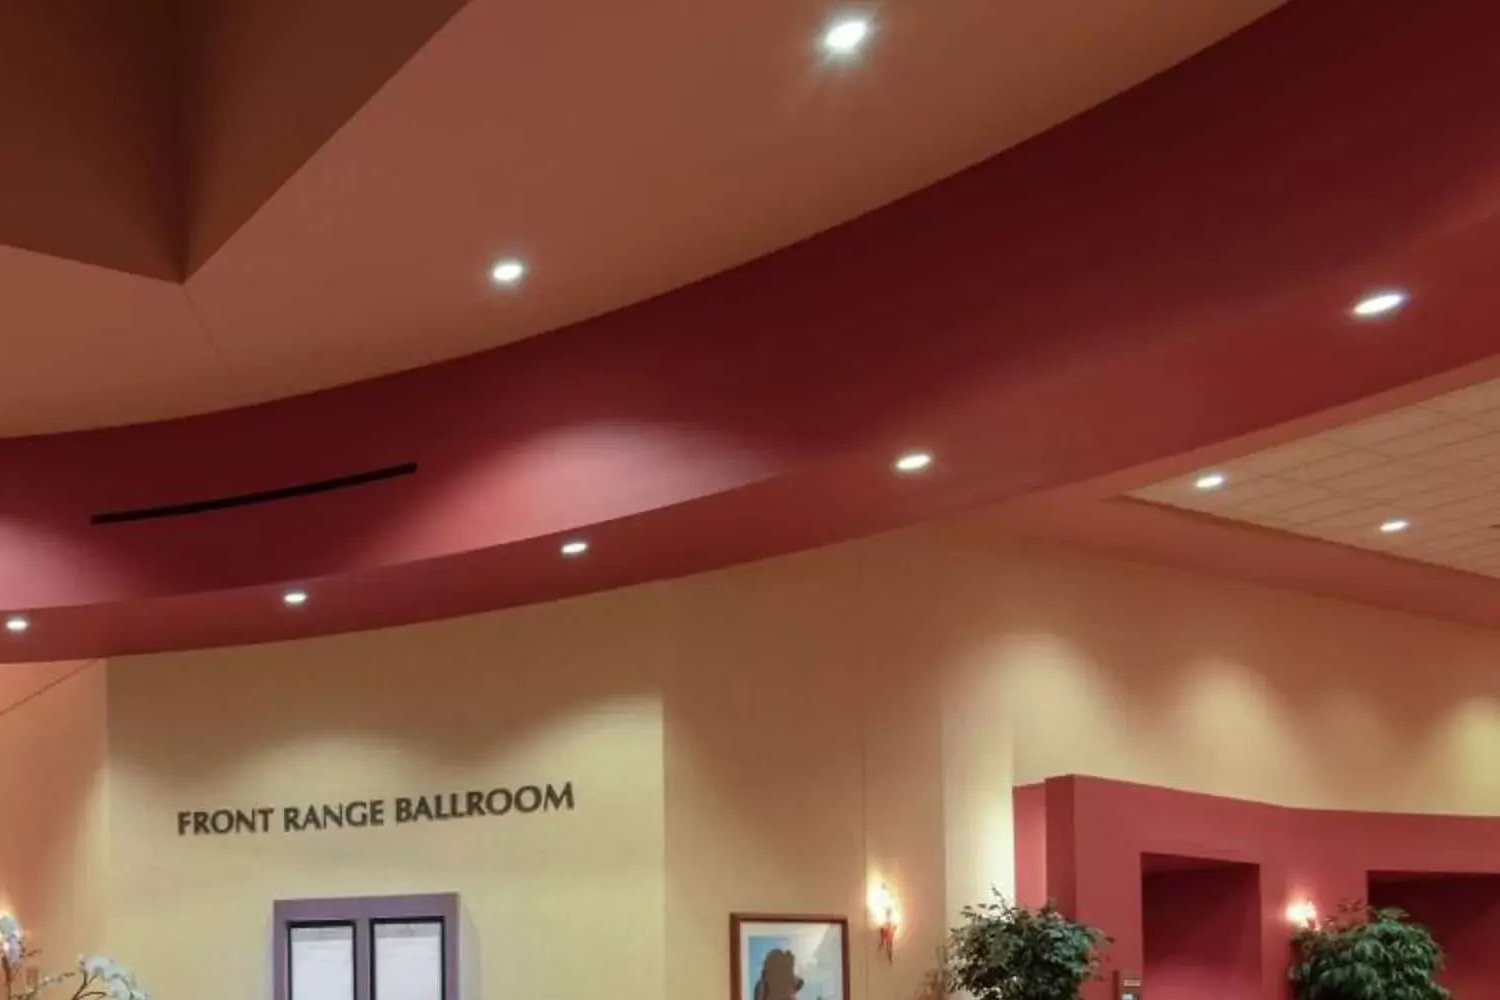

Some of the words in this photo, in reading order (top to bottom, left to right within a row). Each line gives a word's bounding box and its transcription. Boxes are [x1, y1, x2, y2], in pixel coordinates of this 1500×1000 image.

[177, 808, 274, 835] FRONT
[283, 800, 385, 832] RANGE
[395, 782, 574, 824] BALLROOM
